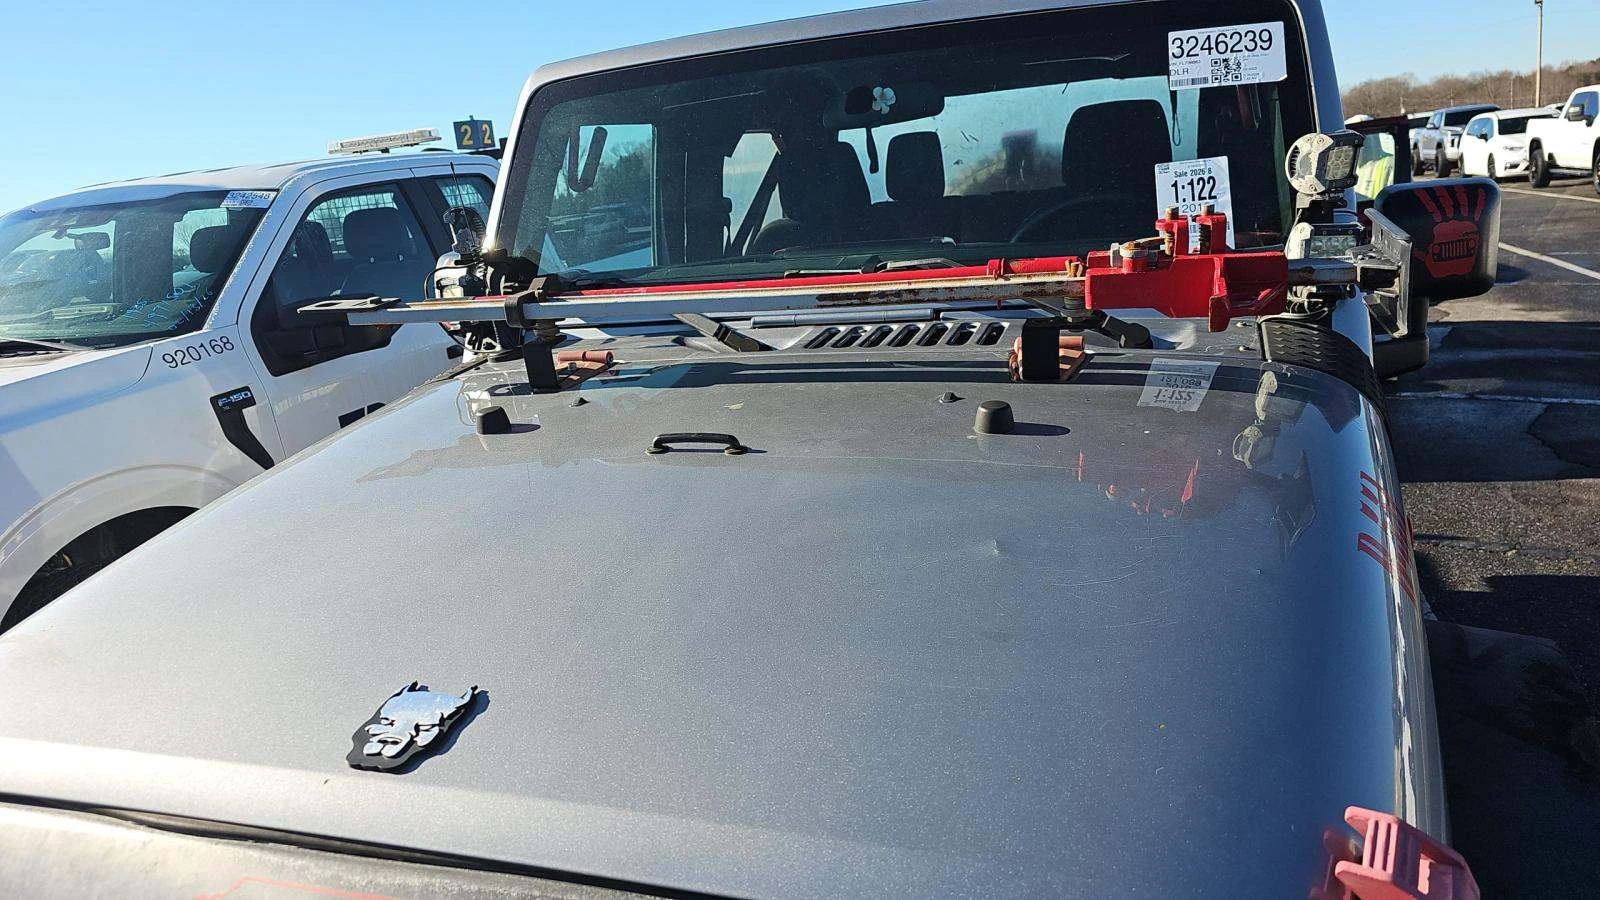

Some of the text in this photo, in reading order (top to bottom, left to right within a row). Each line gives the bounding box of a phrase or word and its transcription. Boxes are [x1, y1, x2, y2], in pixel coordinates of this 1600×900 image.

[1171, 28, 1273, 59] 3246239
[1170, 68, 1189, 77] DLR
[461, 124, 474, 146] 2
[482, 123, 492, 145] 2
[1174, 169, 1188, 178] Sale
[1190, 168, 1206, 177] 2026
[1171, 175, 1218, 204] 1:122
[162, 336, 235, 369] 920168
[218, 391, 252, 407] F-150
